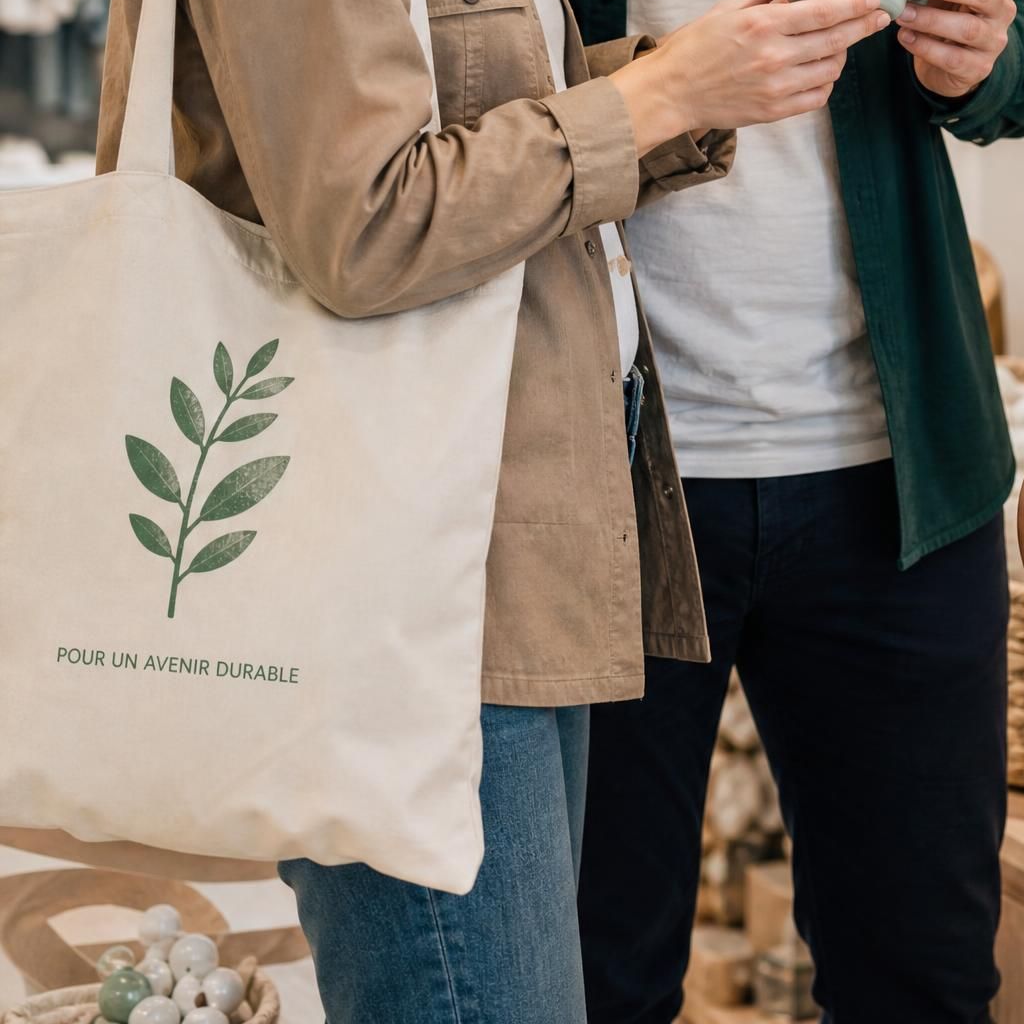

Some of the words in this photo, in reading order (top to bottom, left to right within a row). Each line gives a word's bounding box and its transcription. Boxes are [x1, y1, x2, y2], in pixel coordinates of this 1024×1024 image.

[57, 647, 105, 667] POUR
[112, 652, 137, 669] UN
[144, 655, 209, 675] AVENIR
[216, 661, 299, 683] DURABLE
